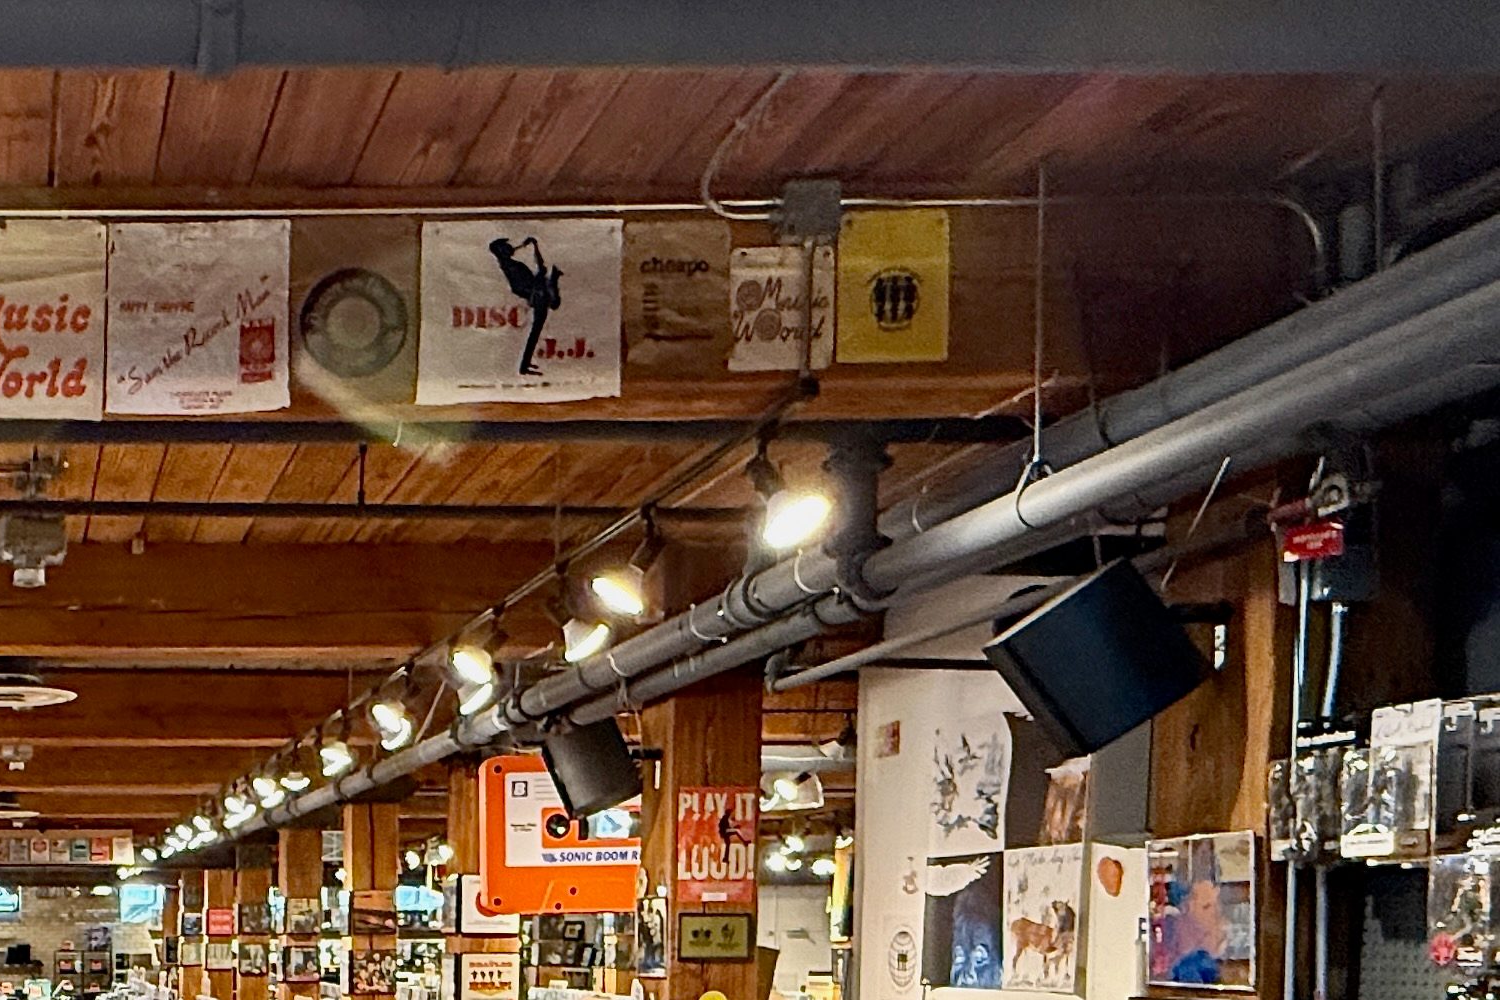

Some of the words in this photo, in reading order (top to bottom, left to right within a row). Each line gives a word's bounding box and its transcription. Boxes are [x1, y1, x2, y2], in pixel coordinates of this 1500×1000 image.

[640, 257, 709, 277] cheapo
[763, 276, 830, 311] Muic
[452, 305, 528, 329] DISC
[537, 337, 595, 359] J.J.
[678, 791, 728, 821] PLAY
[734, 792, 755, 821] IT
[559, 851, 593, 863] SONIC
[595, 850, 629, 862] BOOM
[677, 843, 755, 881] LOUD!
